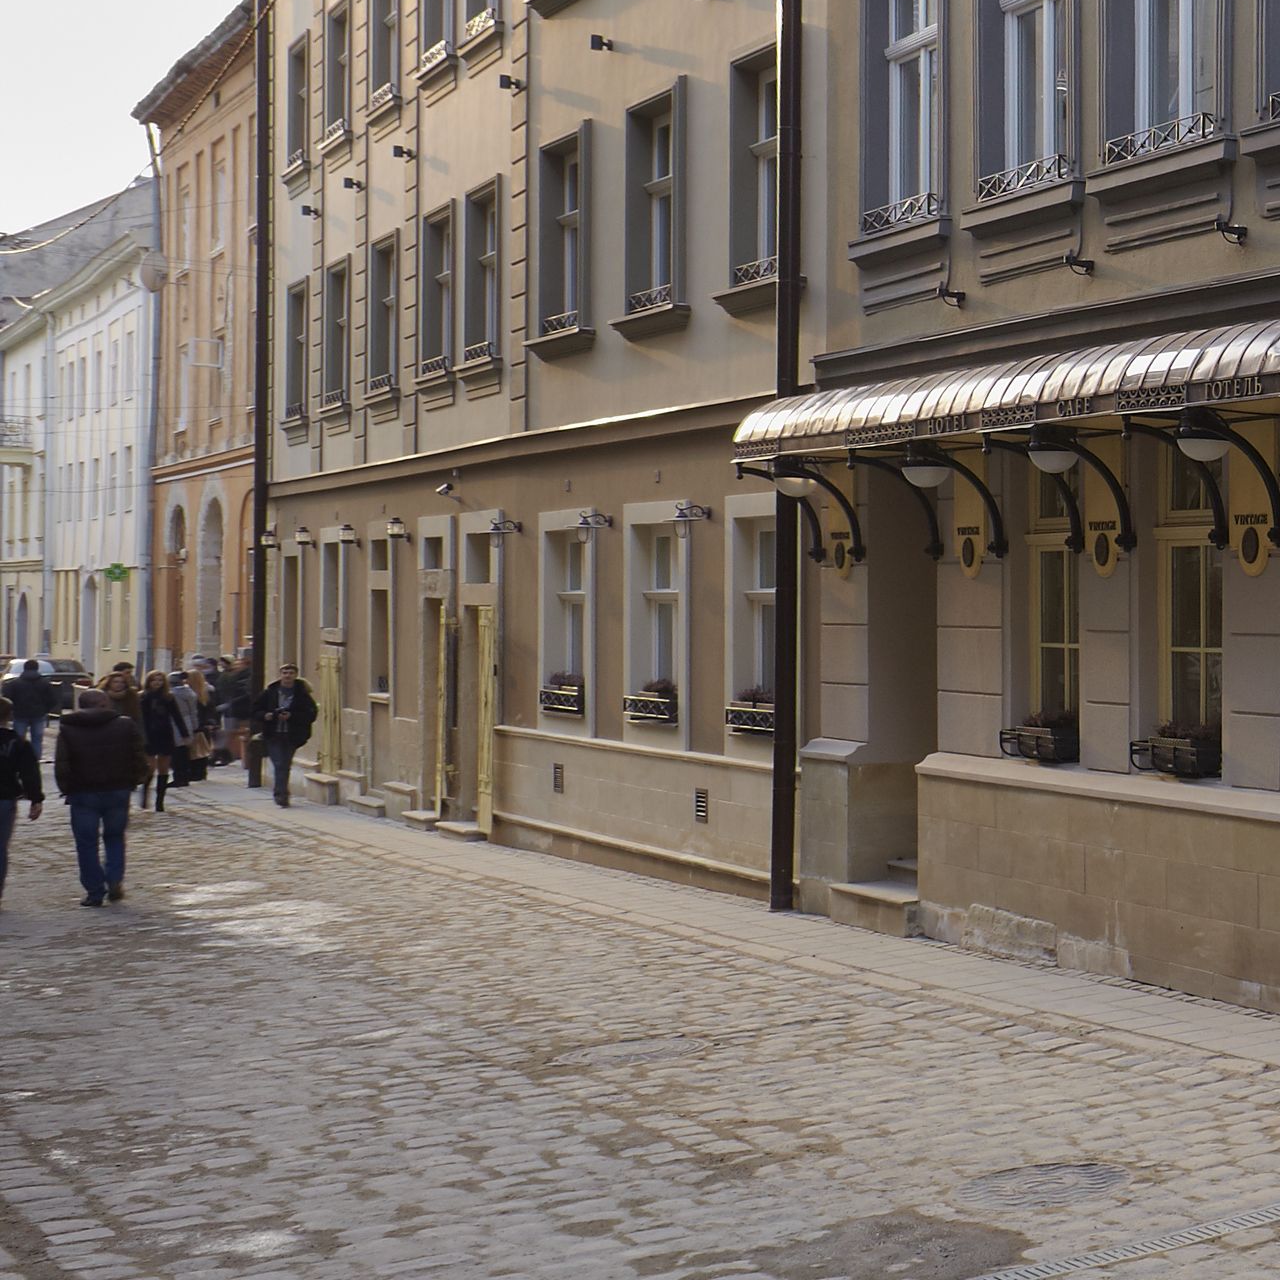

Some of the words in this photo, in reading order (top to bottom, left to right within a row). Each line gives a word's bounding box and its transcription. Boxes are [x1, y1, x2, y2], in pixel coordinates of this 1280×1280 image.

[1204, 377, 1263, 400] ГОТЕЛЬ
[1056, 396, 1094, 418] CAFE
[927, 413, 968, 435] HOTEL
